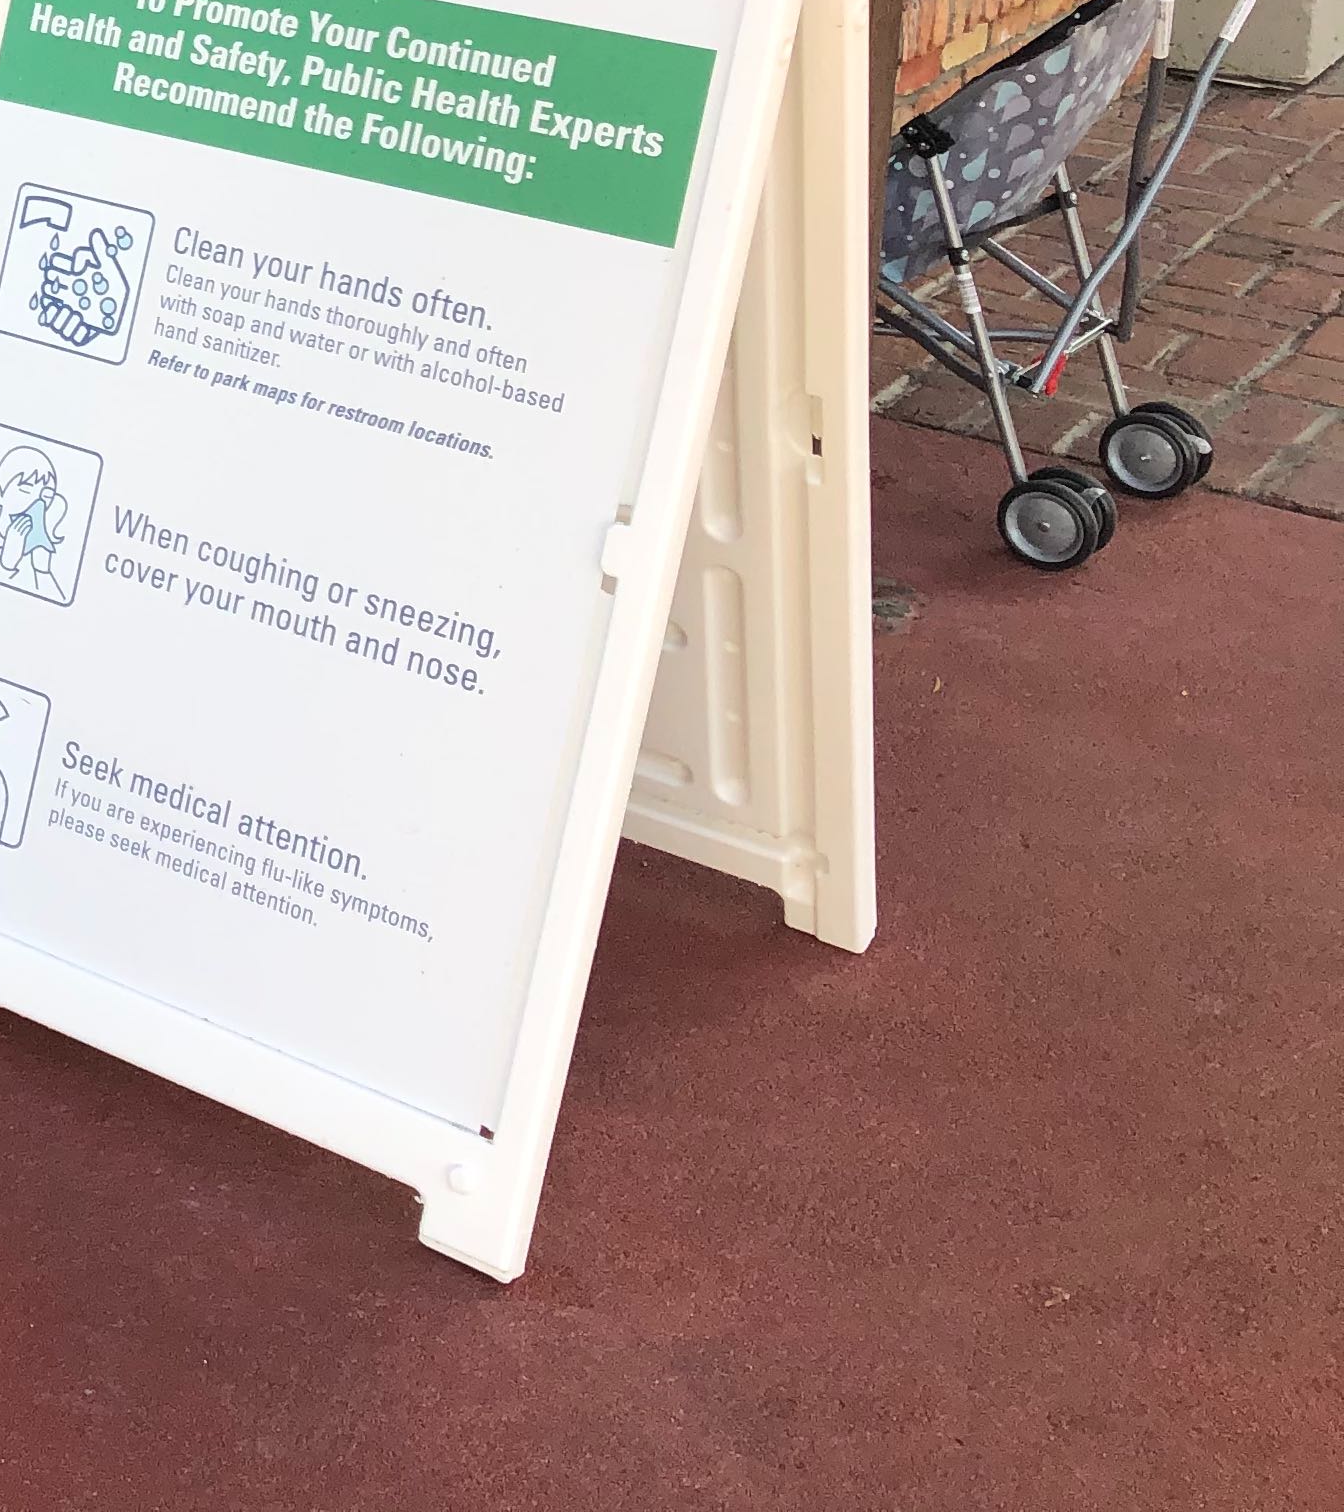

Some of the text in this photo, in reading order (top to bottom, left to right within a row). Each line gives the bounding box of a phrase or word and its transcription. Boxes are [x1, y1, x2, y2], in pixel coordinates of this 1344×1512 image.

[29, 2, 665, 157] Health and Safety, Public Health Experts
[309, 10, 380, 53] Your
[386, 26, 557, 88] Continued
[113, 61, 537, 185] Recommend the Following:
[166, 264, 527, 374] Clean your hands thoroughly and often
[174, 226, 492, 331] Clean your hands often.
[154, 316, 281, 368] hand sanitizer.
[160, 294, 565, 413] with soap and water or with alcohol-based
[147, 349, 493, 460] Refer to park maps for restroom locations.
[105, 553, 484, 695] cover your mouth and nose.
[115, 505, 501, 659] When coughing or sneezing,
[48, 808, 317, 927] please seek medical attention.
[55, 777, 433, 943] If you are experiencing flu-like symptoms,
[61, 740, 367, 881] Seek medical attention.
